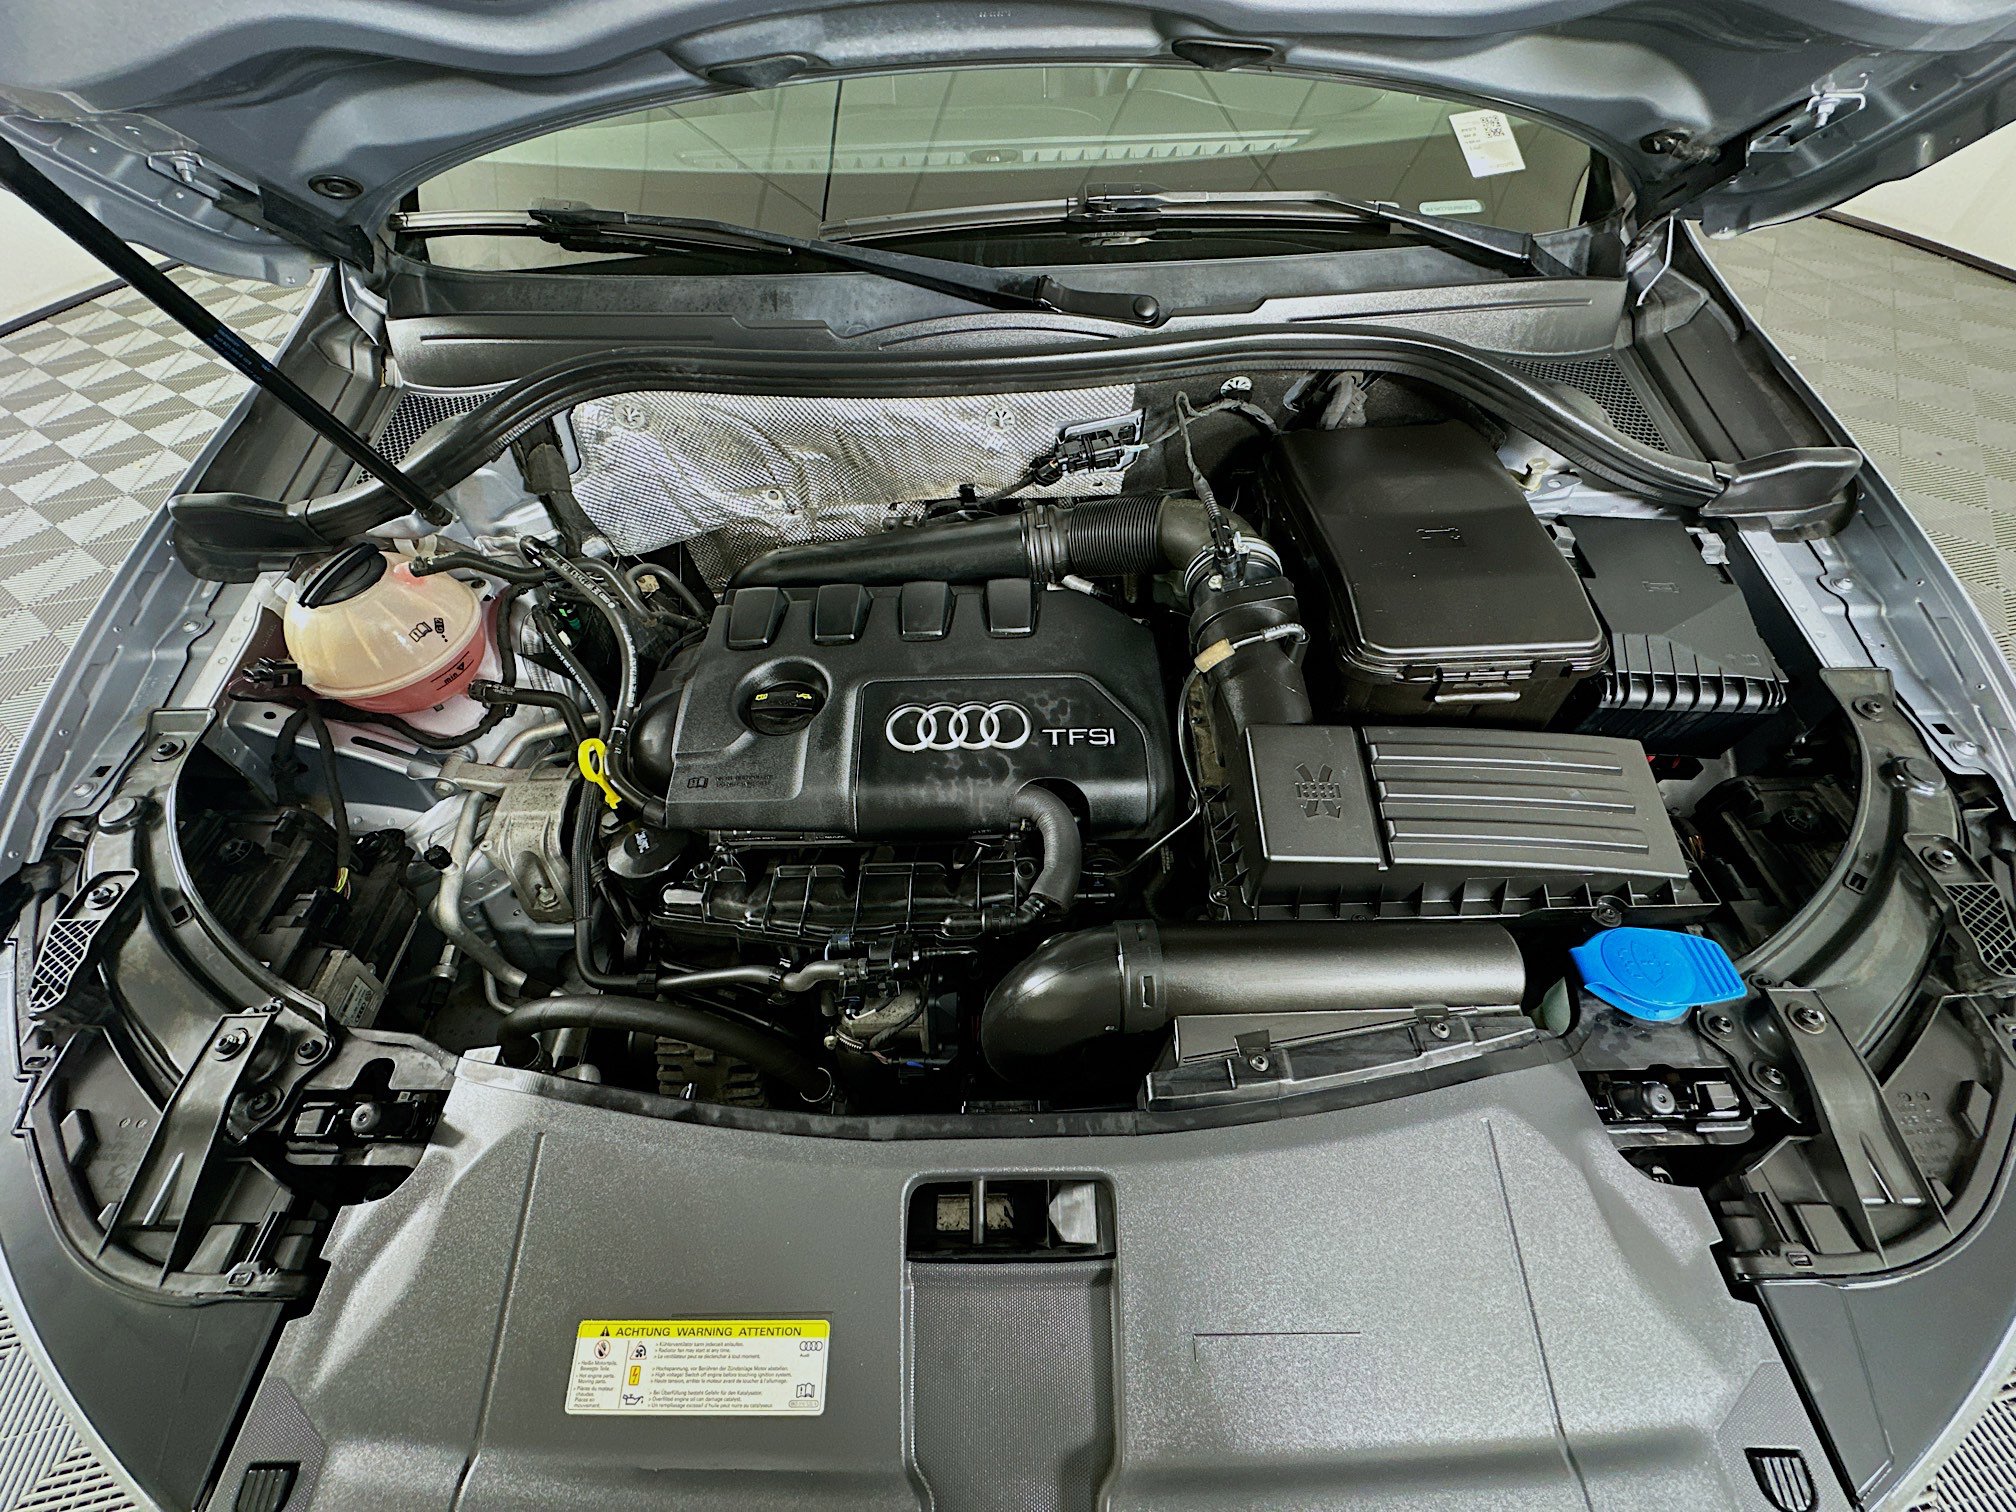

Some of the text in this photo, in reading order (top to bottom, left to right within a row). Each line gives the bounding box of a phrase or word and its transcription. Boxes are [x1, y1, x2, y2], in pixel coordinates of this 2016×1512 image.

[443, 672, 459, 685] min
[1041, 727, 1116, 747] TFSI
[616, 1327, 802, 1337] ACHTUNG WARNING ATTENTION
